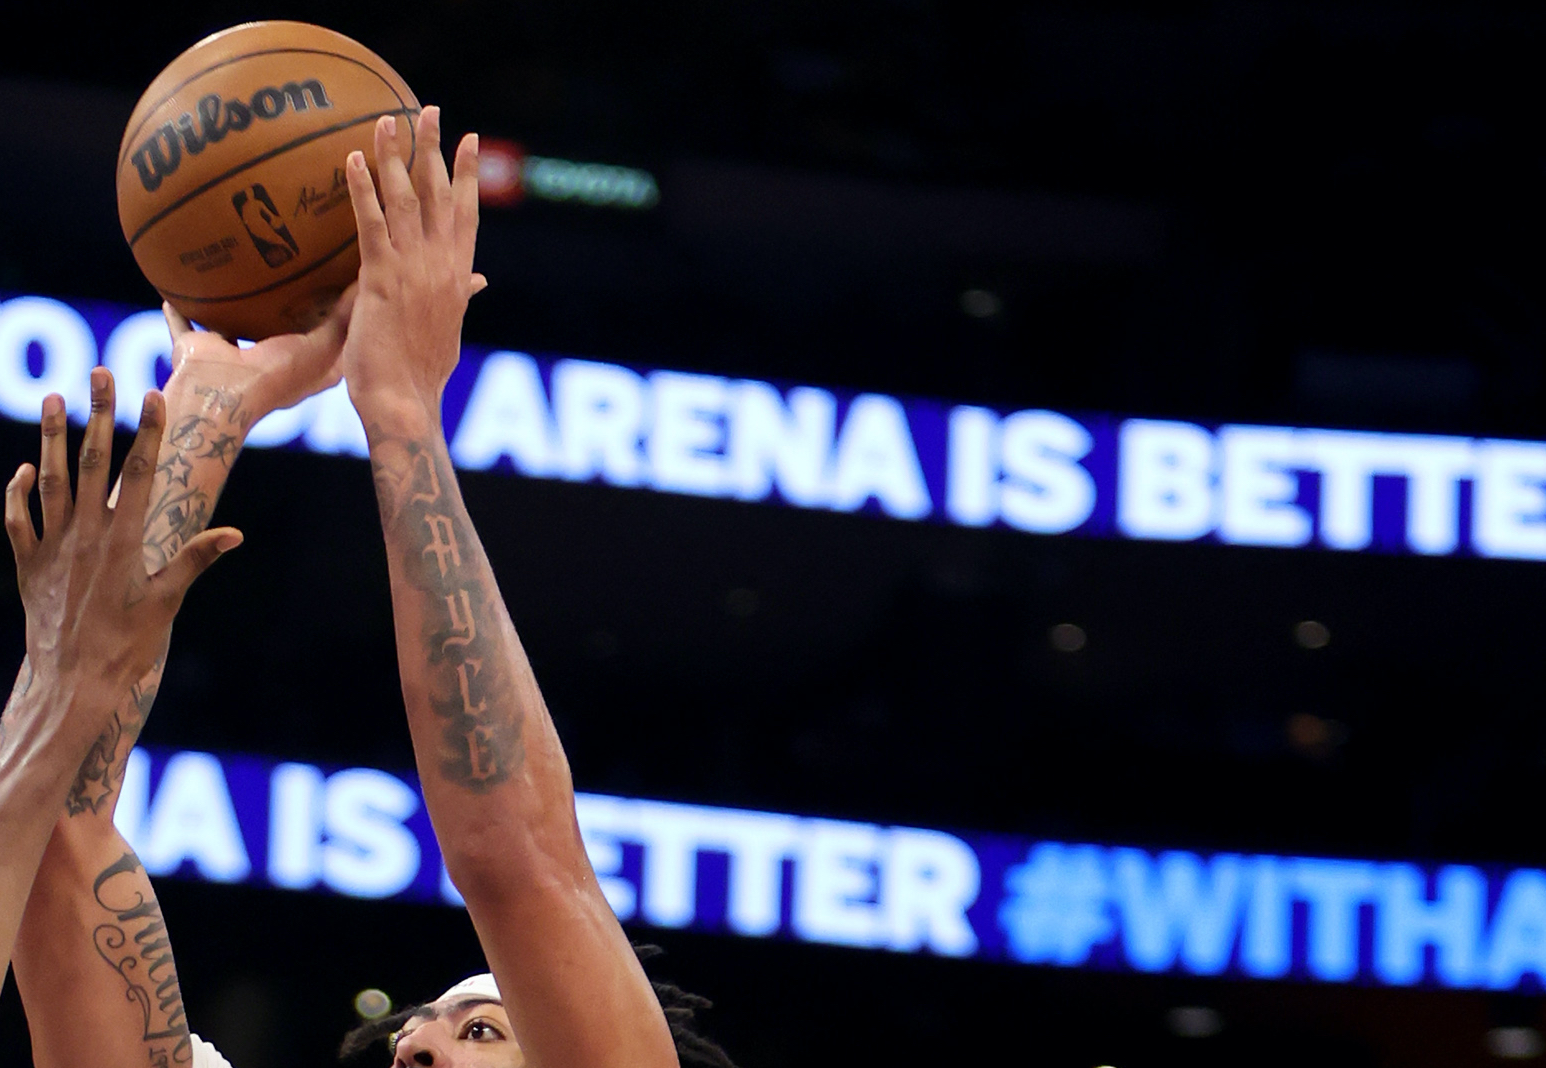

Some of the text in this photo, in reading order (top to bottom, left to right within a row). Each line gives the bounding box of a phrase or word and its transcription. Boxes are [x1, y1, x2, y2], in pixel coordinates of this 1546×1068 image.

[130, 78, 334, 193] Wilson
[449, 349, 934, 521] ARENA
[945, 403, 1098, 535] IS
[1114, 417, 1546, 561] BETTE
[266, 761, 423, 900] IS
[439, 790, 980, 959] ETTER
